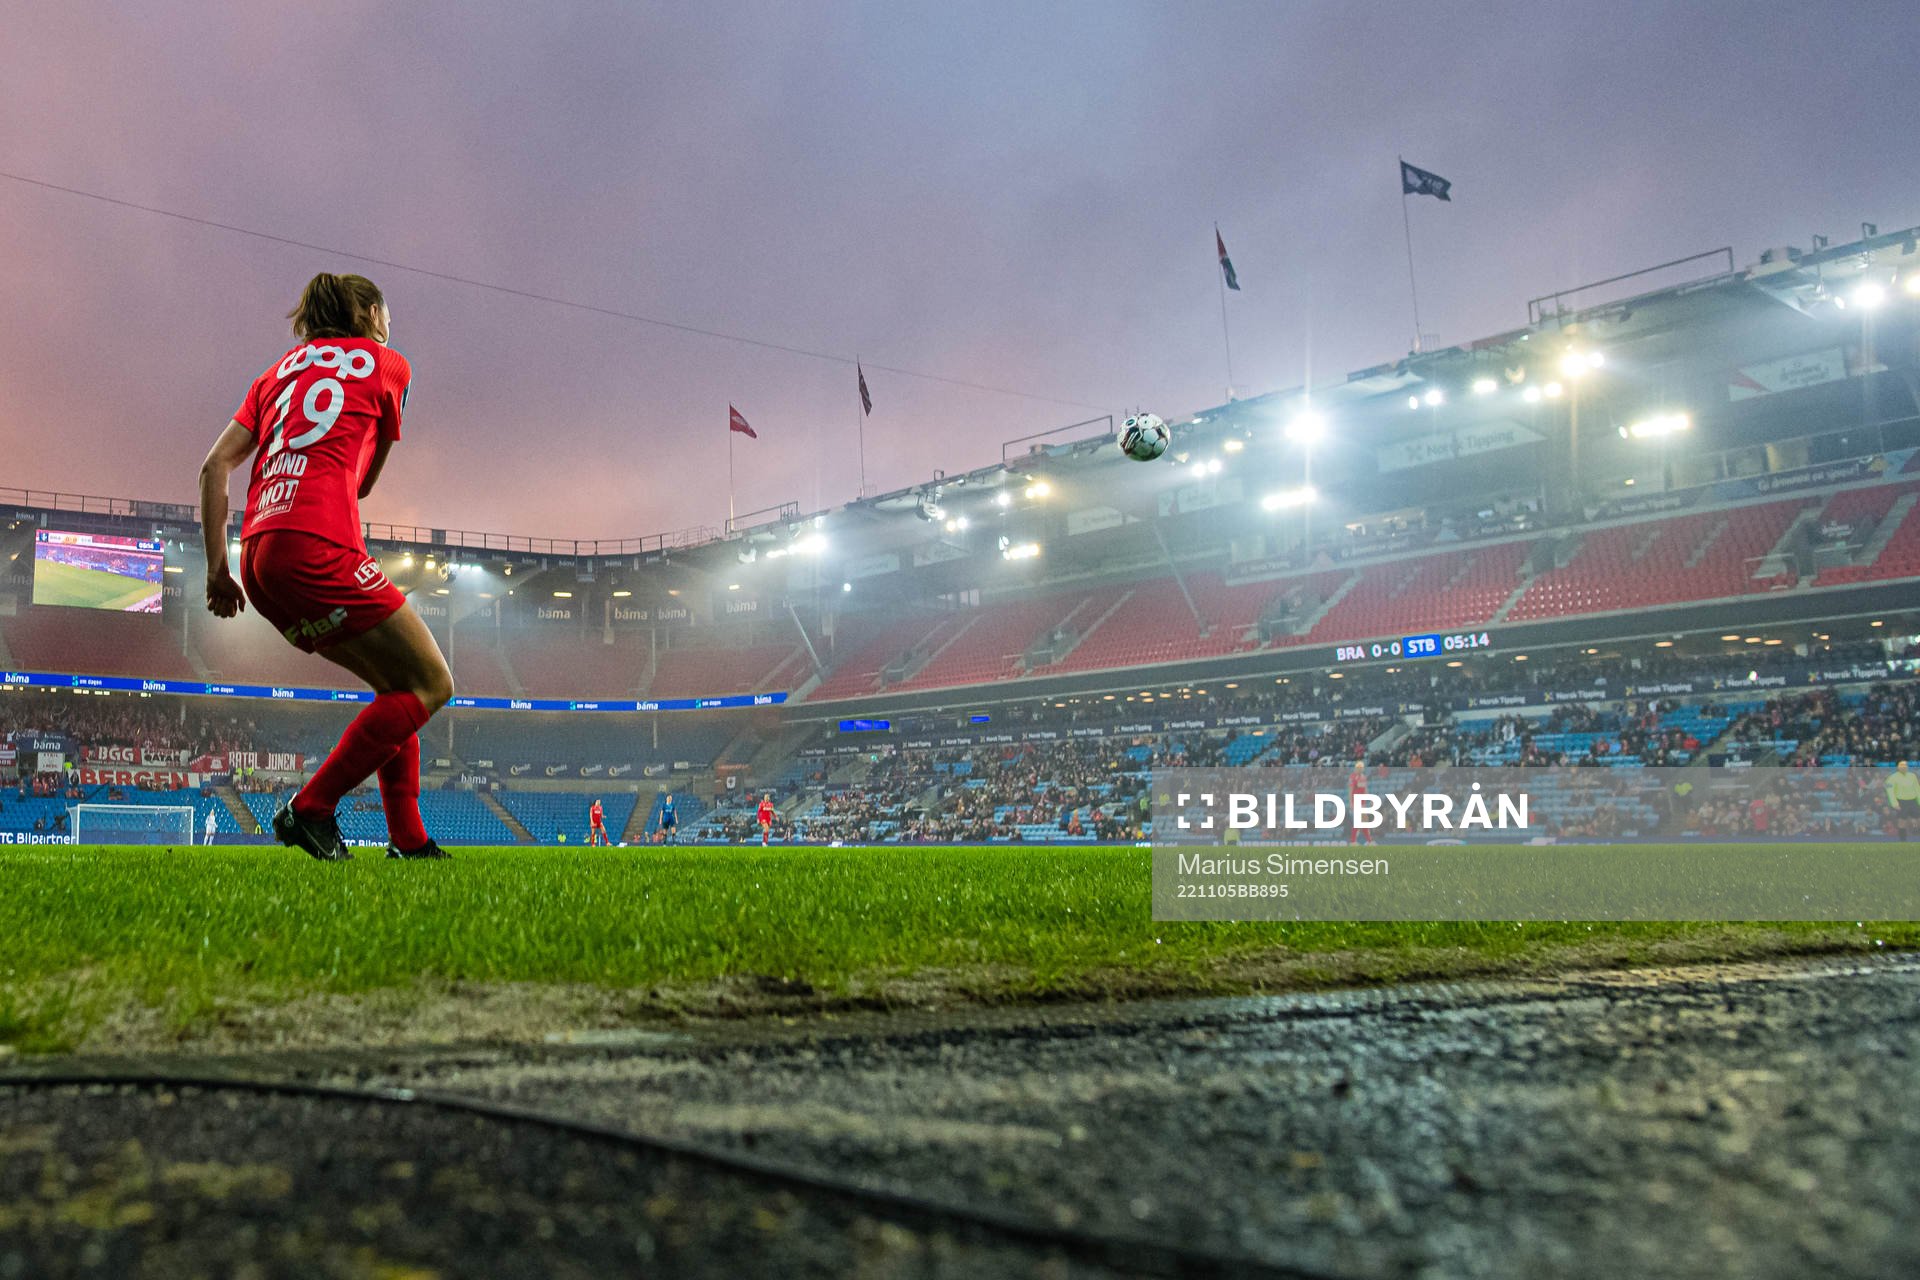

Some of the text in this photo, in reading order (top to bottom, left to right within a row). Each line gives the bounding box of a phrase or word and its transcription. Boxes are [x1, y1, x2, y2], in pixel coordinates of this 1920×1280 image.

[276, 344, 375, 381] coop
[267, 378, 344, 457] 19
[258, 480, 299, 511] MOT
[538, 607, 571, 619] bama
[1336, 646, 1365, 661] BRA
[1408, 638, 1436, 654] STB
[1444, 632, 1490, 650] 05:14
[5, 671, 30, 684] bama
[142, 680, 166, 691] bama
[272, 687, 294, 698] bama
[510, 698, 532, 710] bama
[636, 700, 659, 711] bama
[33, 738, 61, 750] bama
[80, 770, 189, 787] BERGEN
[461, 773, 487, 784] bama
[17, 832, 76, 845] Bilpartner
